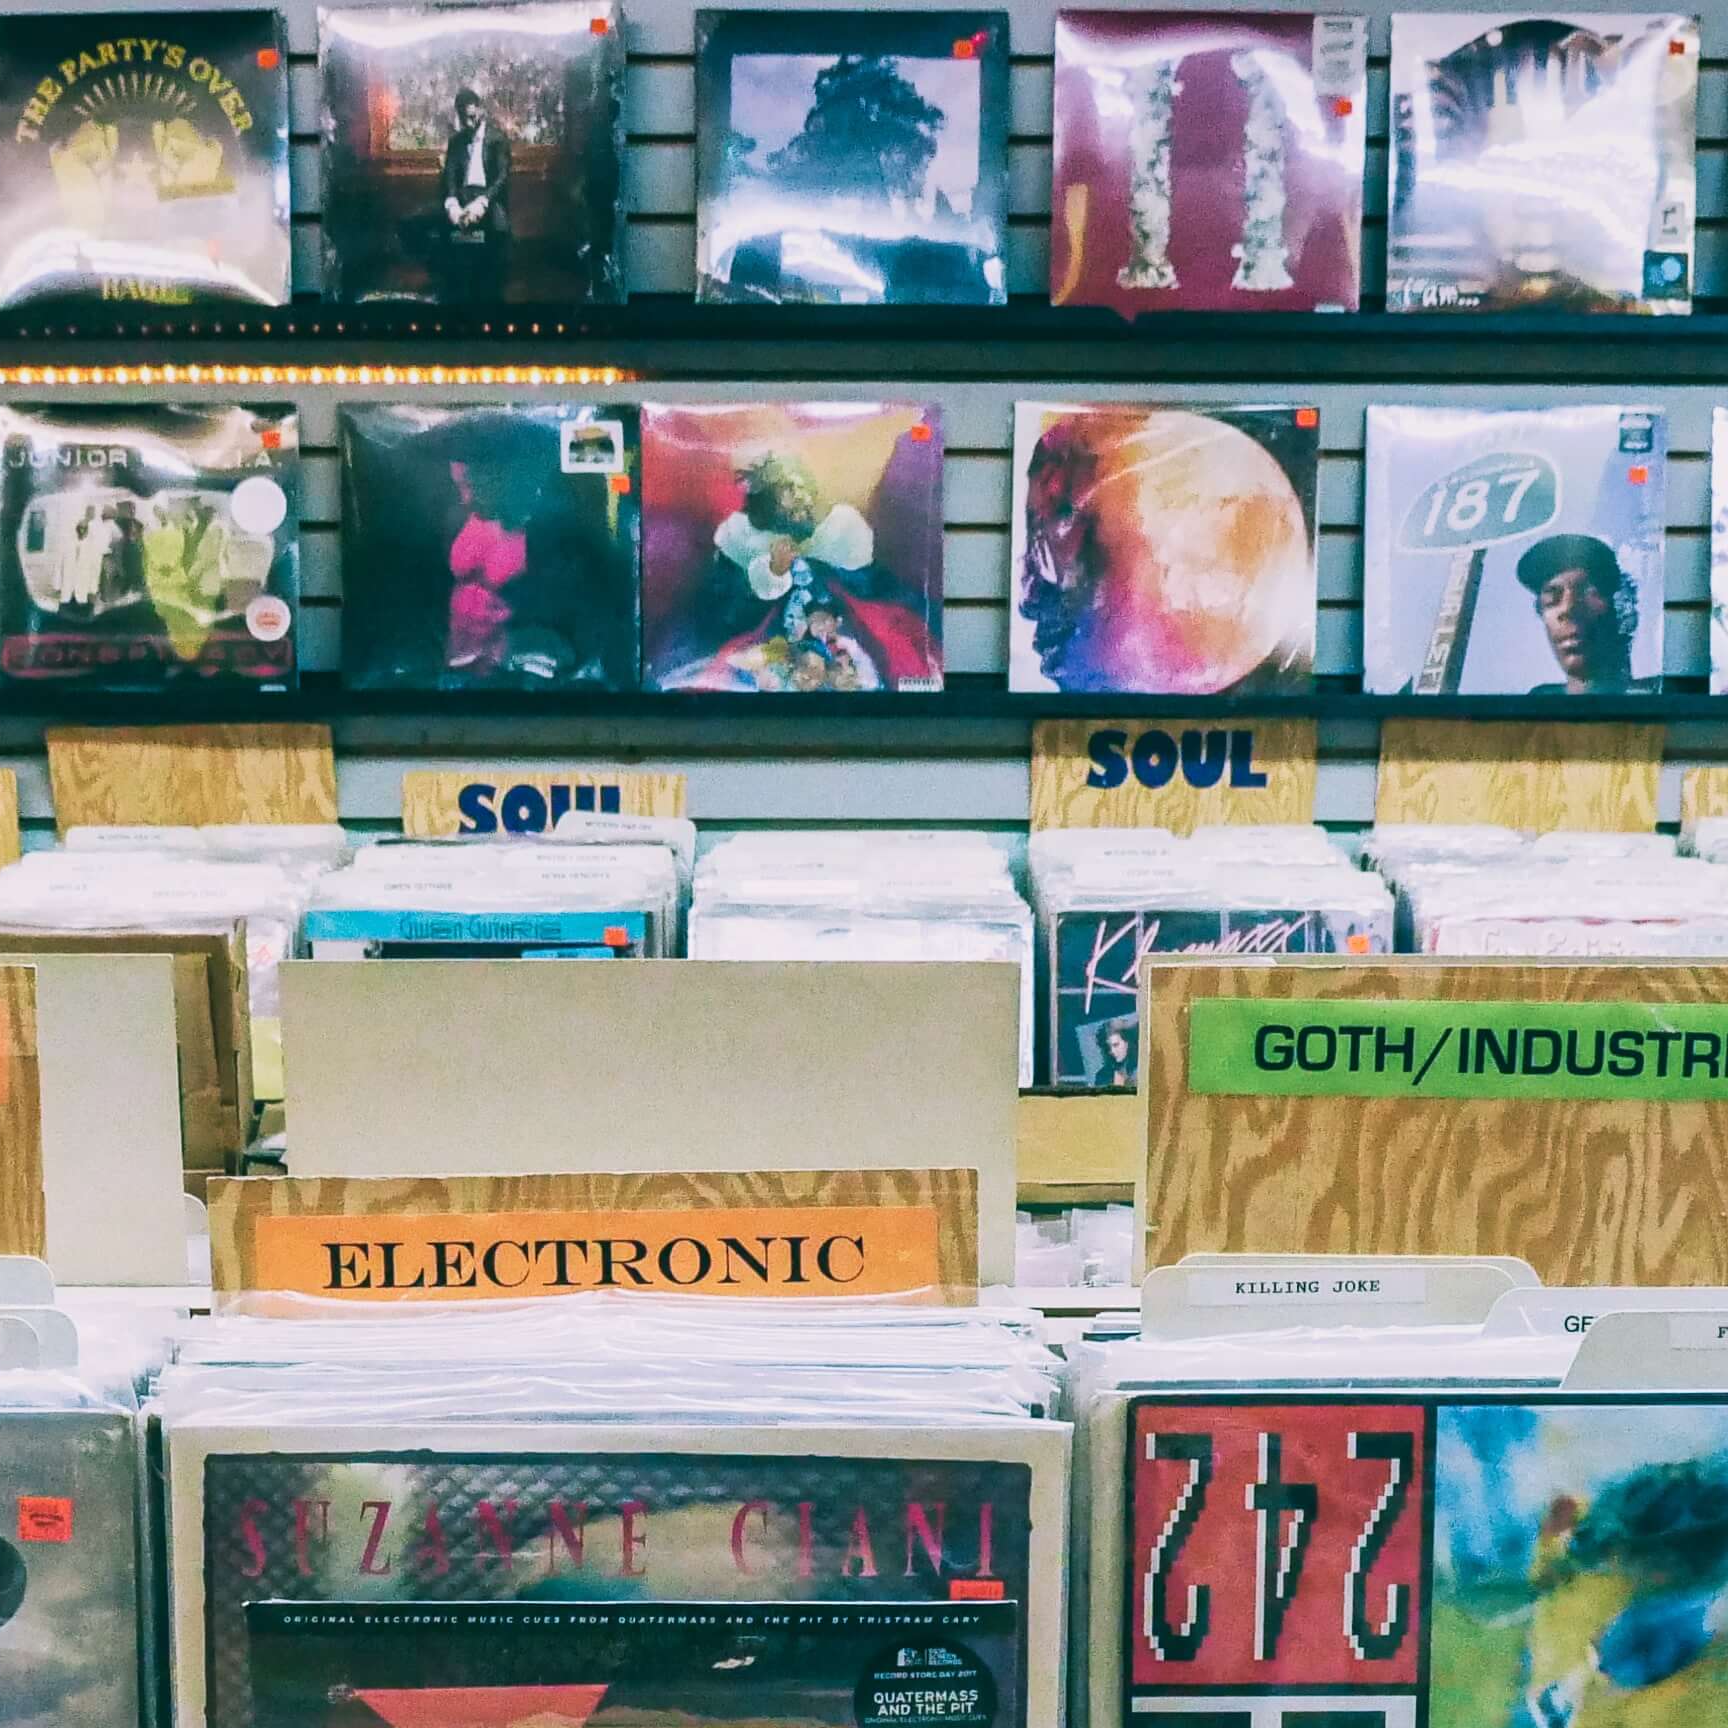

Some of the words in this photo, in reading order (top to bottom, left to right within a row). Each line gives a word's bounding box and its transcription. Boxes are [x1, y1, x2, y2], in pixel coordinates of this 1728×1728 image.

[16, 76, 63, 143] THE
[59, 38, 186, 84] PARTY'S
[189, 58, 253, 137] OVER
[1425, 468, 1541, 536] 187
[1086, 729, 1268, 789] SOUL
[321, 1236, 865, 1291] ELECTRONIC
[1235, 1280, 1320, 1296] KILLING
[1331, 1279, 1381, 1295] JOKE
[237, 1500, 652, 1577] SUZANNE
[729, 1500, 996, 1579] CIANI
[873, 1690, 978, 1704] QUATERMASS
[878, 1704, 911, 1715] AND
[915, 1703, 946, 1714] THE
[951, 1702, 975, 1714] PIT
